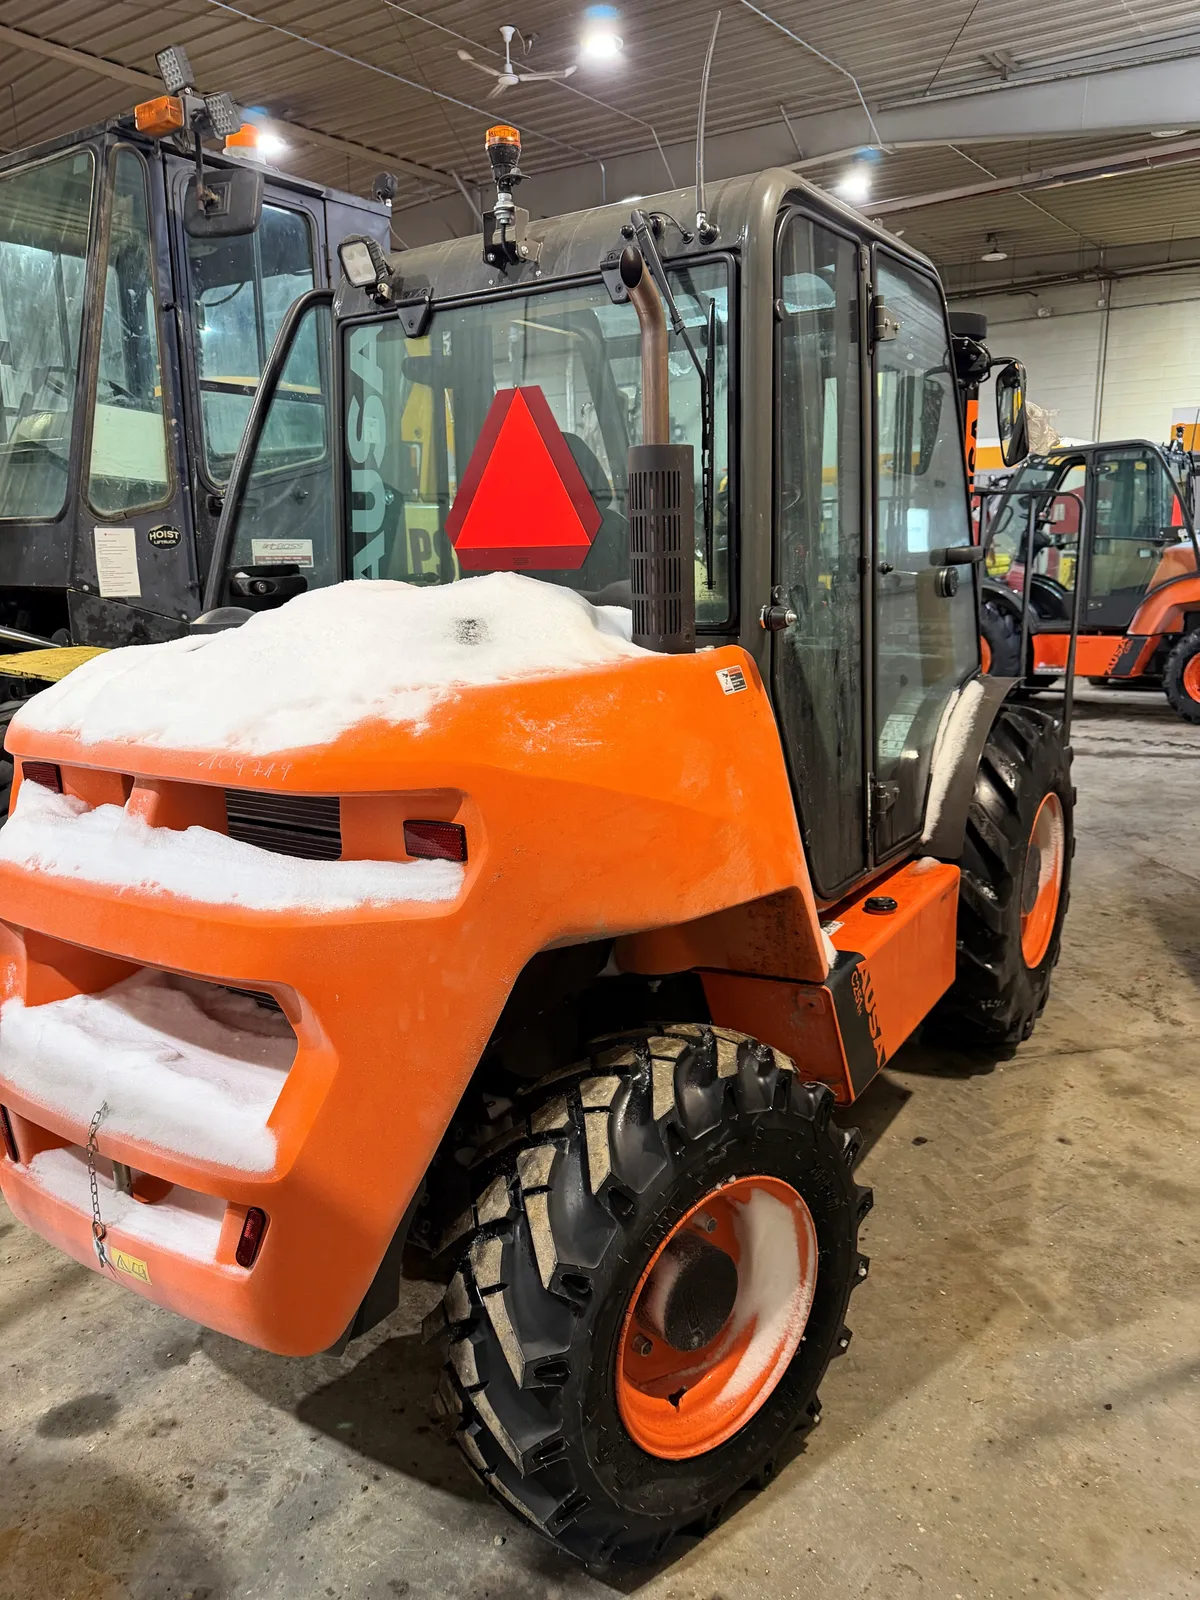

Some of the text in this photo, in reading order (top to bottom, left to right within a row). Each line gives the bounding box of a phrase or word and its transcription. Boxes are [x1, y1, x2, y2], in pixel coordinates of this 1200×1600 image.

[347, 325, 387, 581] AUSA
[149, 530, 180, 541] HOIST
[856, 963, 887, 1069] AUSA
